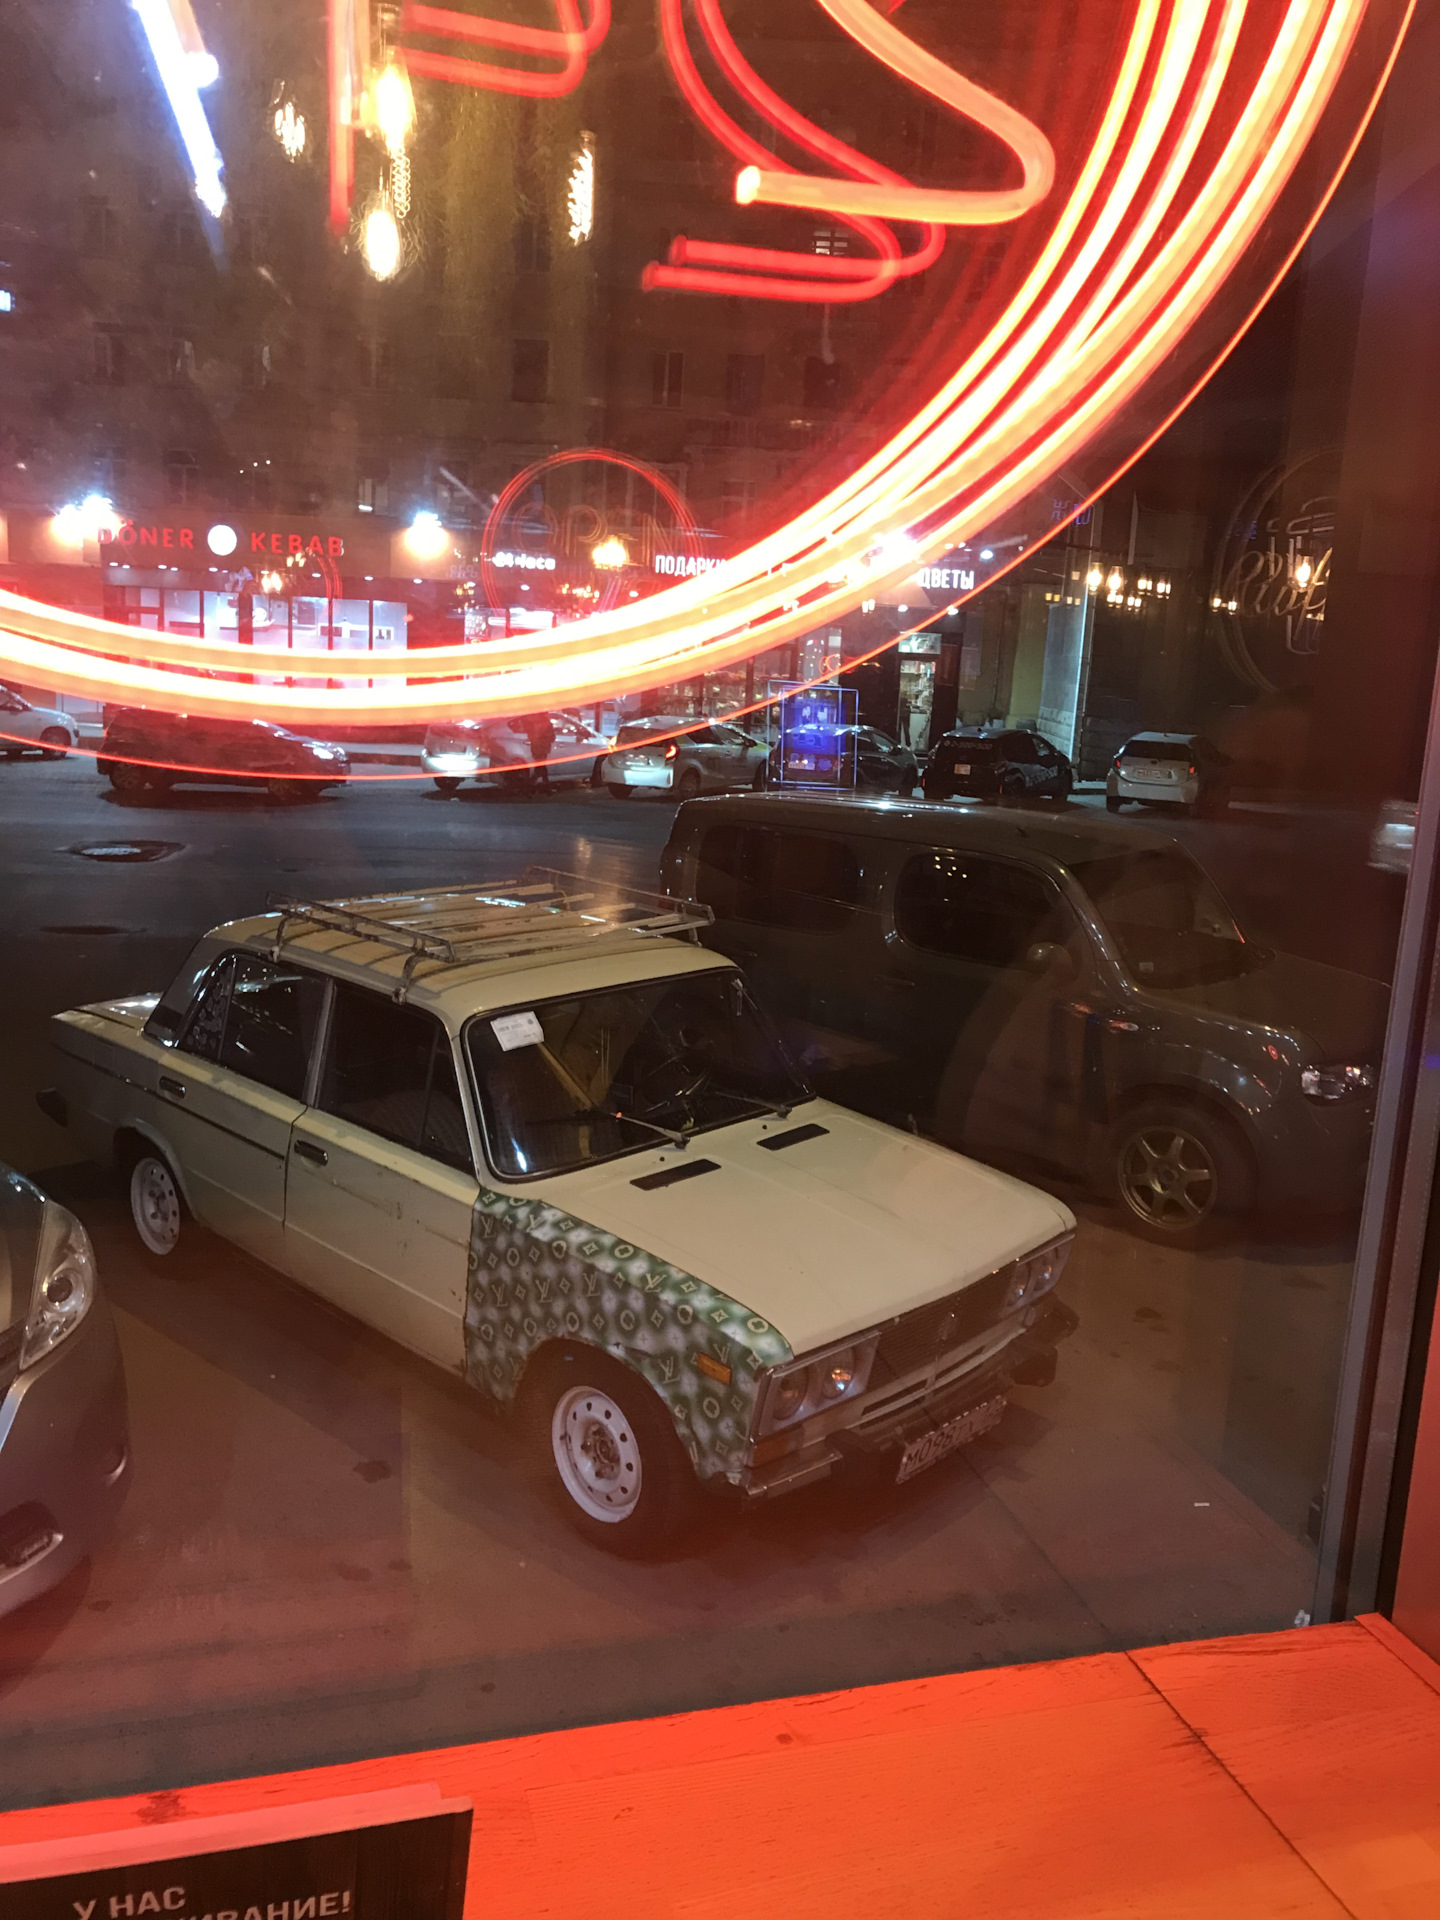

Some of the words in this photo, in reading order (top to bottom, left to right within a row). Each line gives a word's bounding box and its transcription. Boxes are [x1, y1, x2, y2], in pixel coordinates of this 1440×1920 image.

[98, 519, 194, 549] DÖNER
[251, 531, 345, 557] KEBAB
[655, 554, 728, 577] ПОДАРК
[917, 567, 974, 590] ЦВЕТЫ
[72, 1899, 97, 1920] У
[109, 1886, 186, 1919] НАС
[179, 1890, 351, 1920] АНИЕ!
